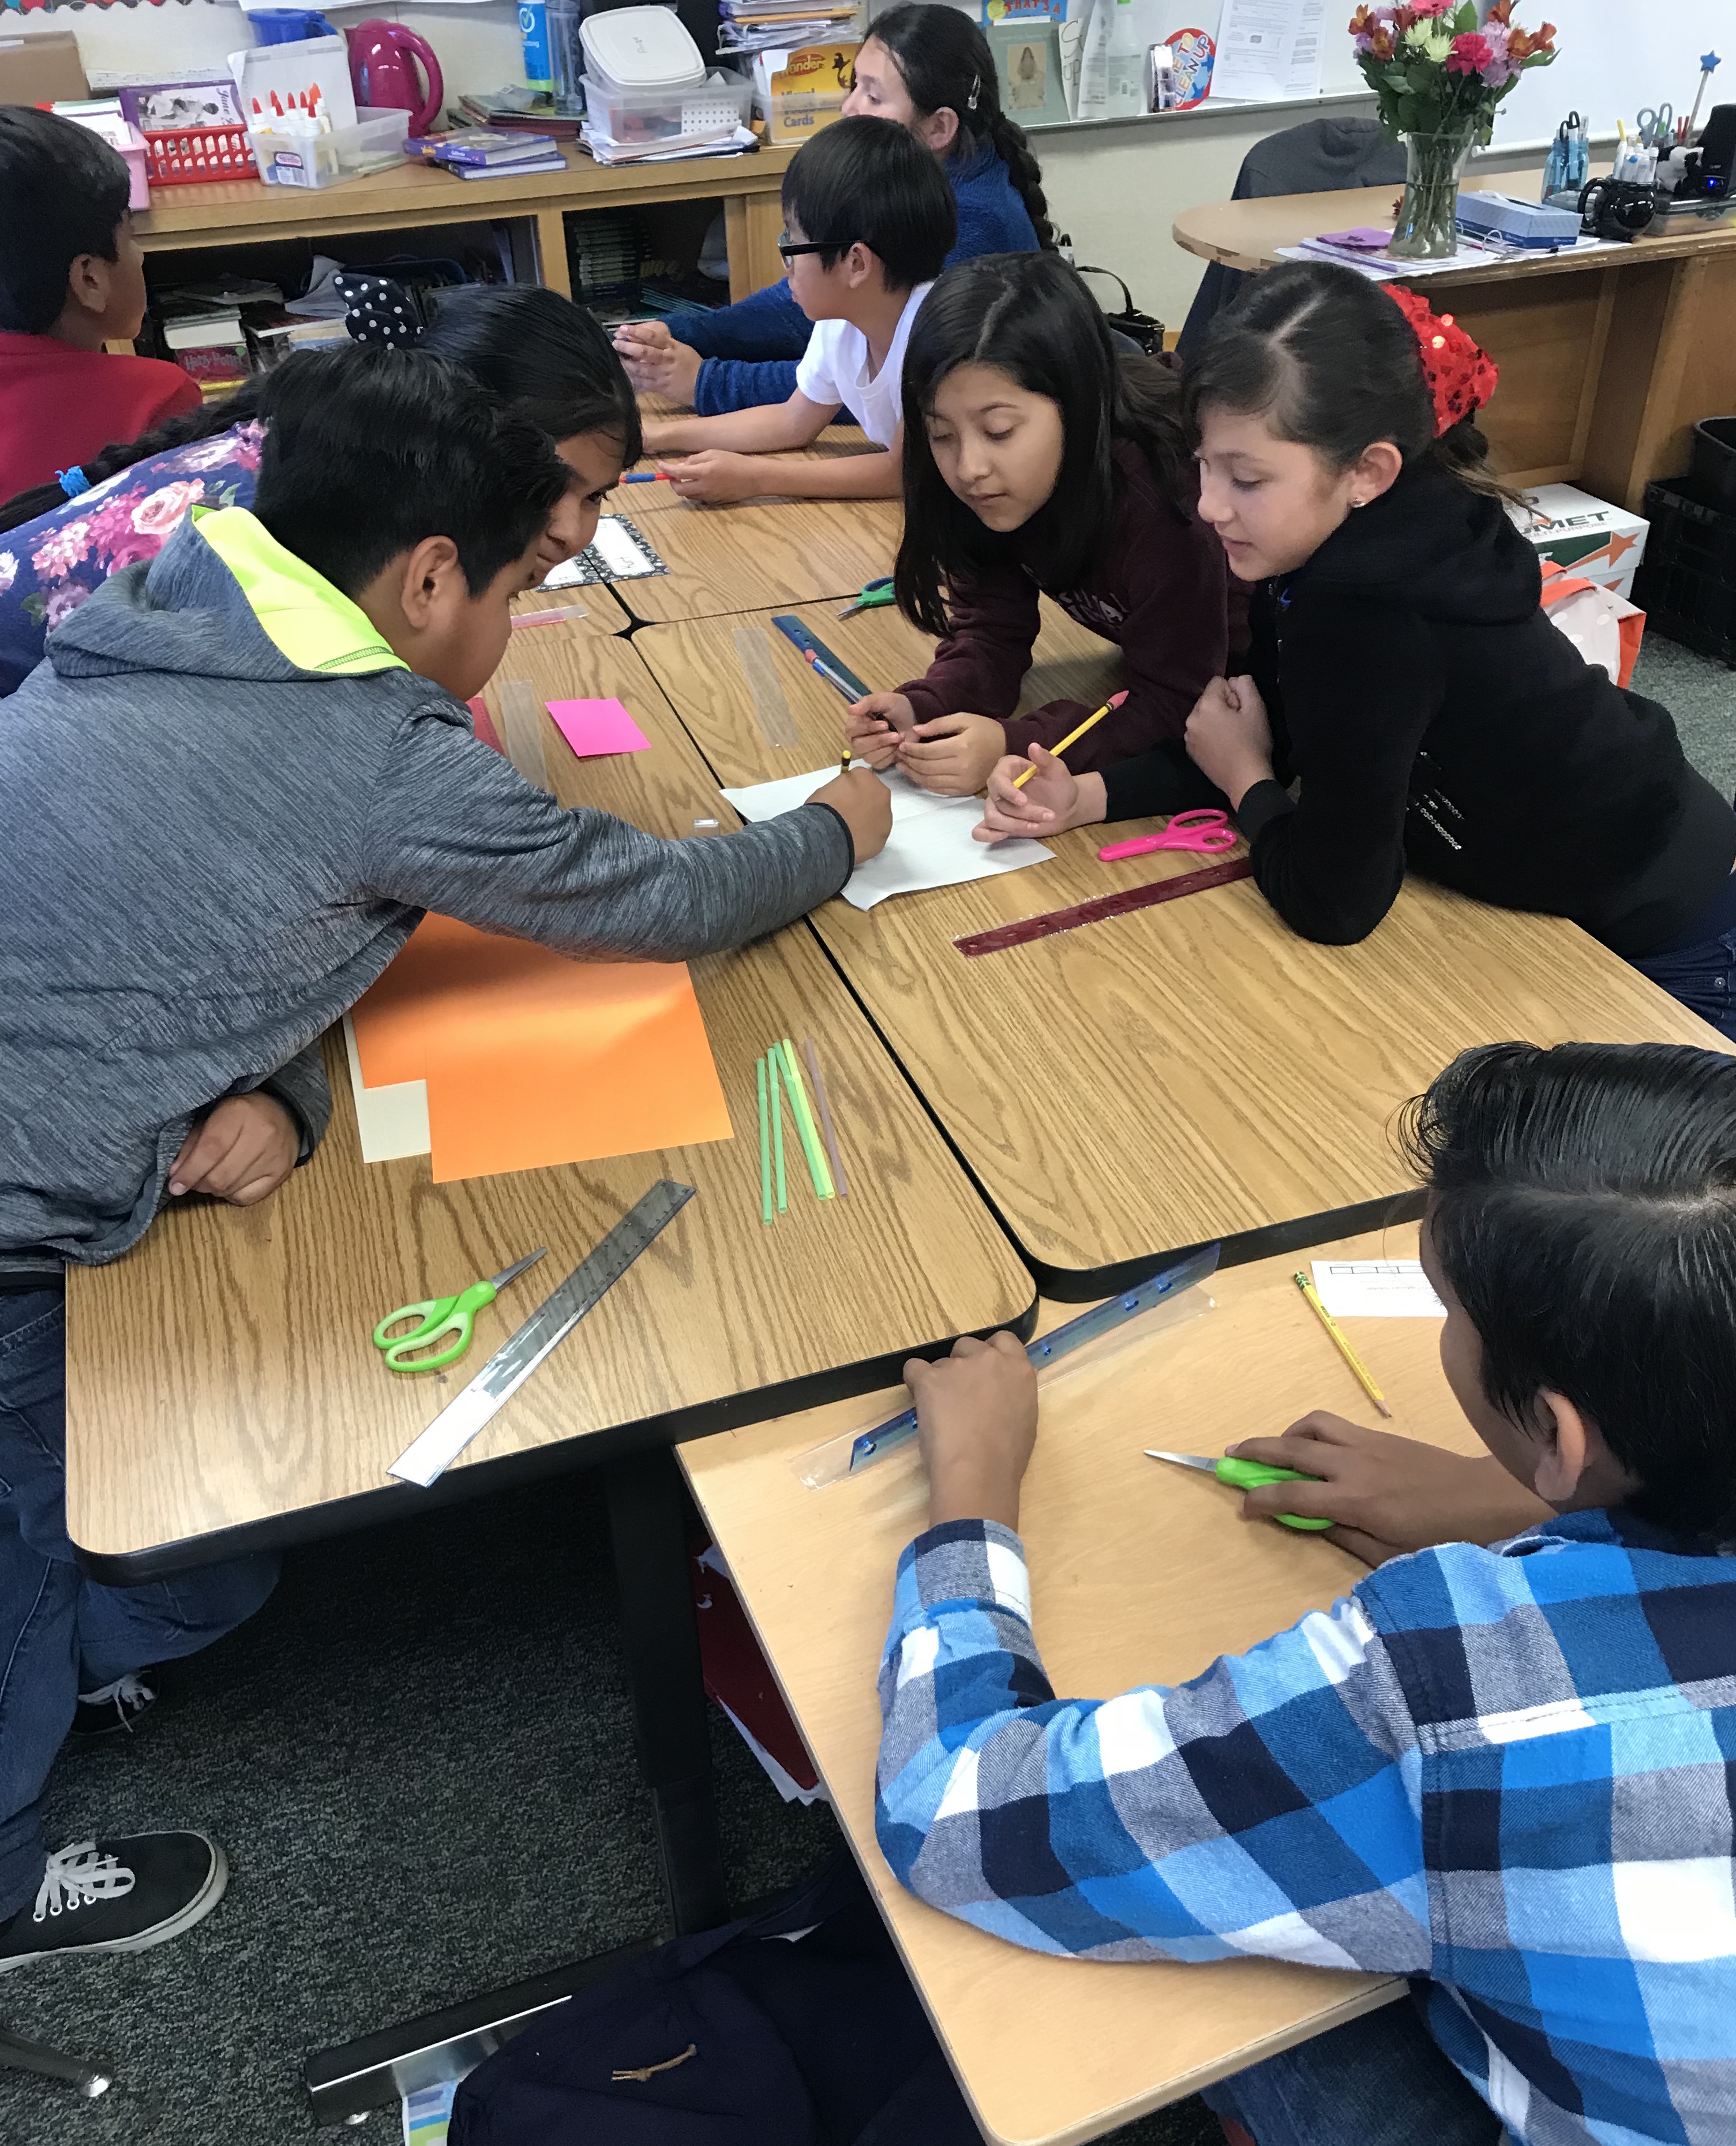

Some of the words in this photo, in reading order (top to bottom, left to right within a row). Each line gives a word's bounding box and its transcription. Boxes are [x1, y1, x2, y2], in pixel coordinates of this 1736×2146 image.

[1177, 32, 1194, 54] TO
[1193, 36, 1208, 58] UP
[216, 88, 230, 115] Jane
[783, 115, 815, 128] Cards
